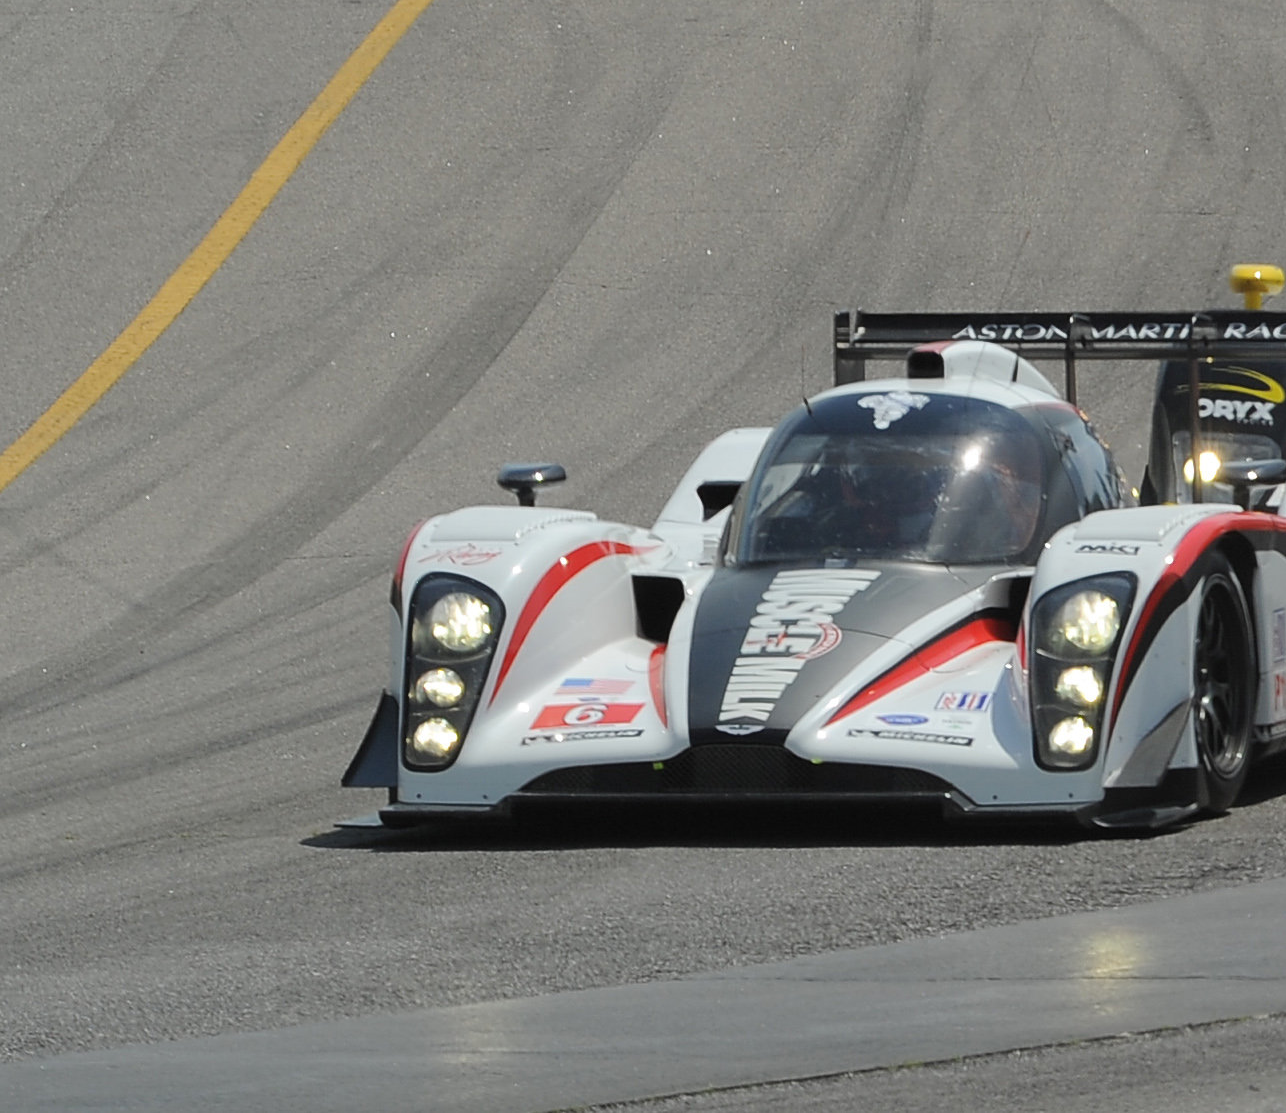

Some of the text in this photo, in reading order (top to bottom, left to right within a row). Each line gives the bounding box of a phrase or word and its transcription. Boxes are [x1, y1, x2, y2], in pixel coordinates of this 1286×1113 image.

[951, 324, 1068, 340] ASTON
[1091, 323, 1190, 340] MARTI
[1197, 398, 1276, 421] ORYX
[718, 568, 882, 722] MUSCLE MILK
[562, 702, 609, 727] 6
[877, 731, 971, 745] MICHELIN
